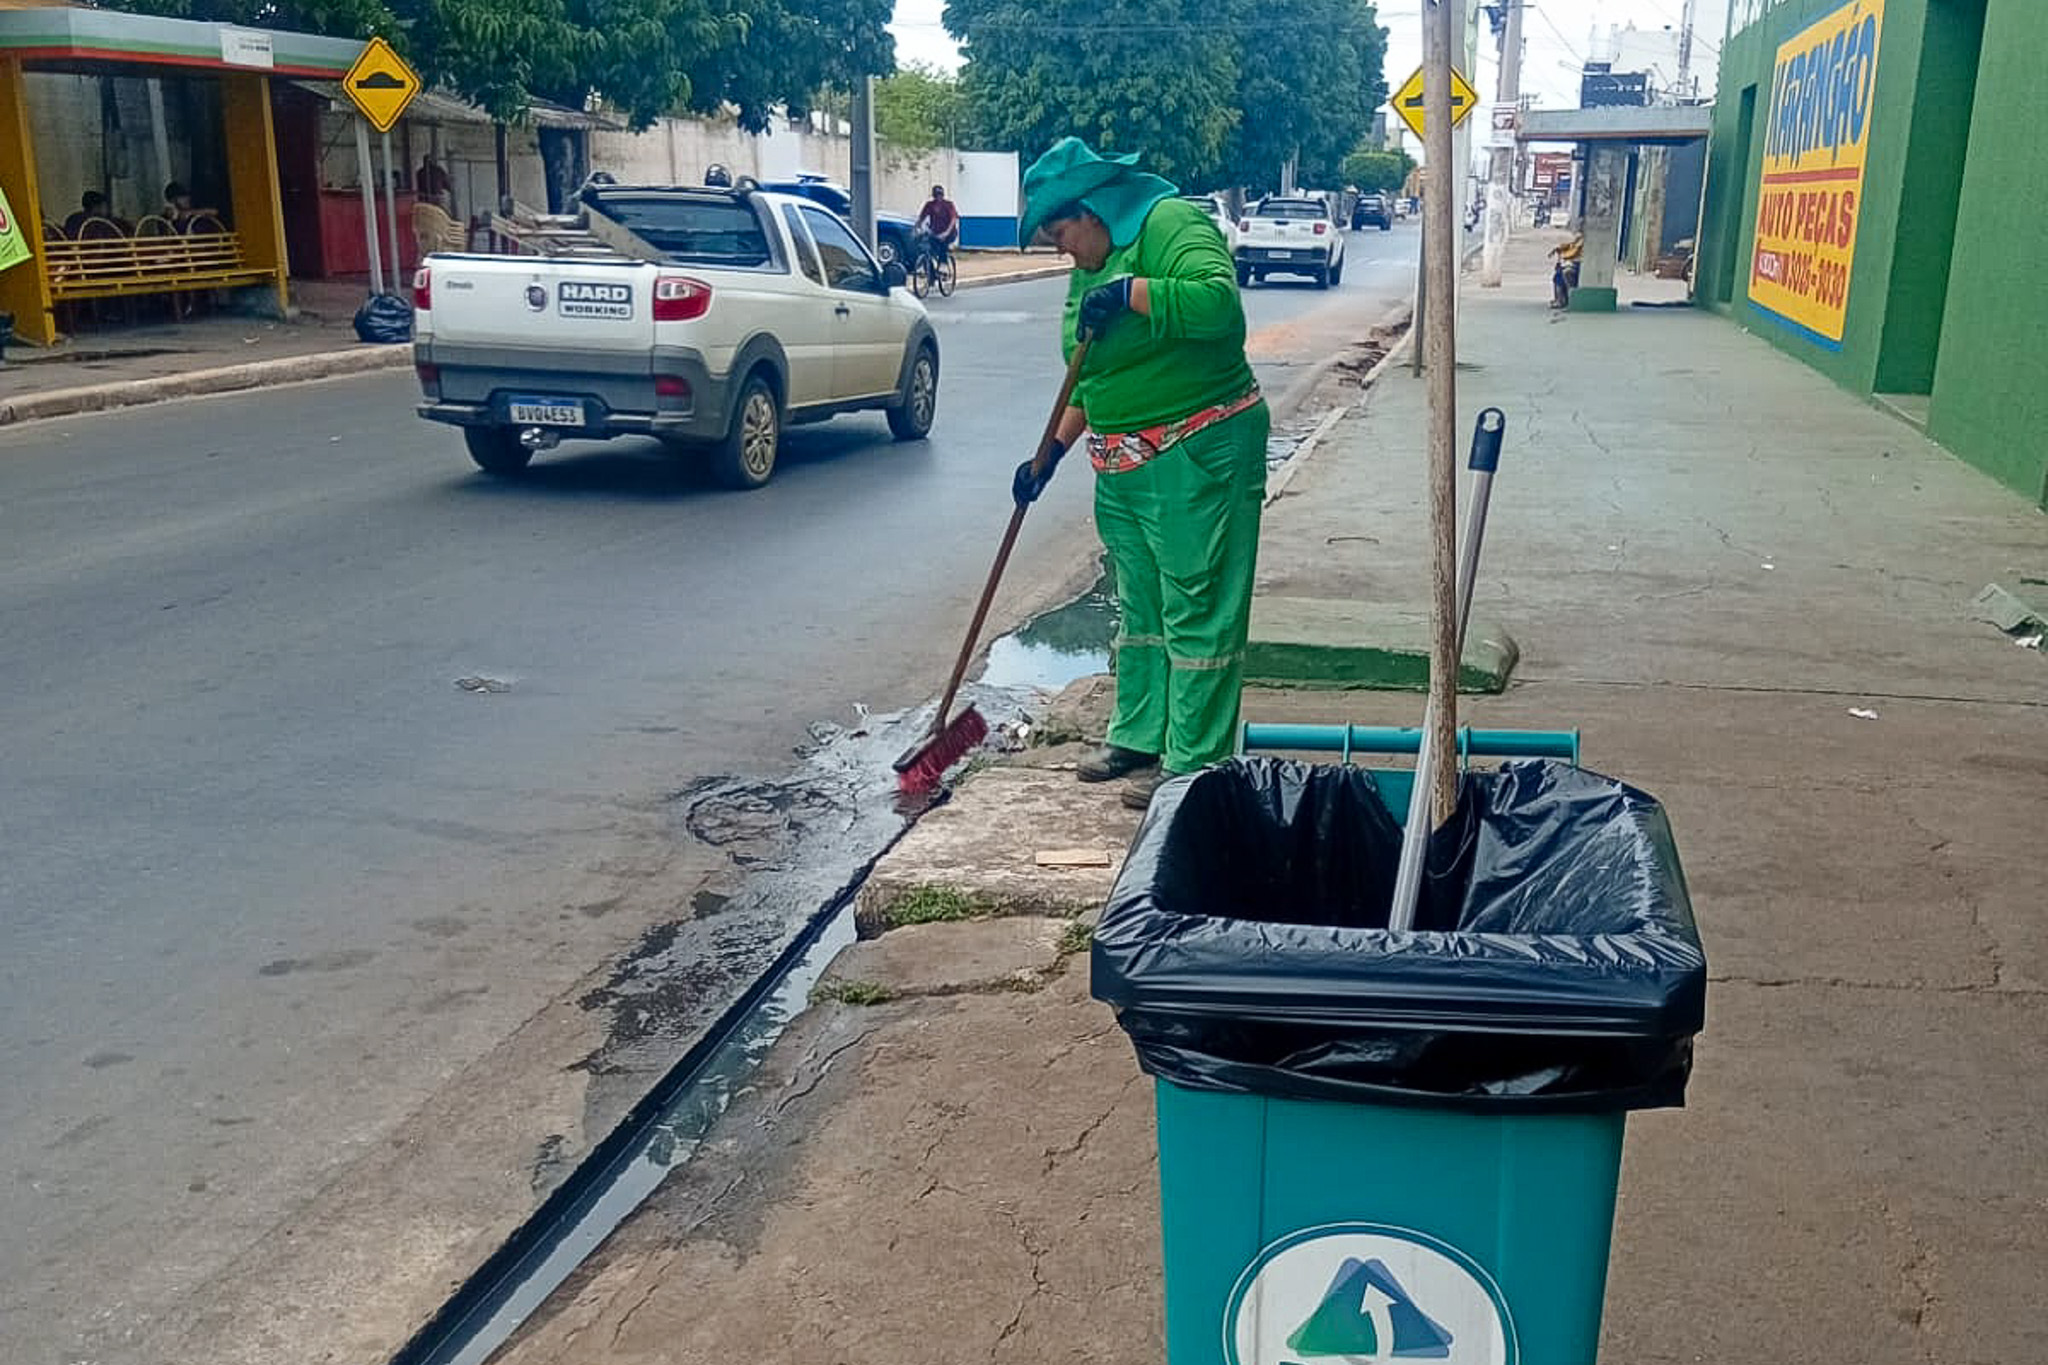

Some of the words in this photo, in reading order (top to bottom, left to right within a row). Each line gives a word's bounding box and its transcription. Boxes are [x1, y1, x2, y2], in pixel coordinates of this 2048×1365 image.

[1759, 190, 1794, 240] AUTO
[1794, 190, 1854, 254] PEÇAS
[562, 284, 629, 301] HARD
[564, 304, 628, 316] WORKING
